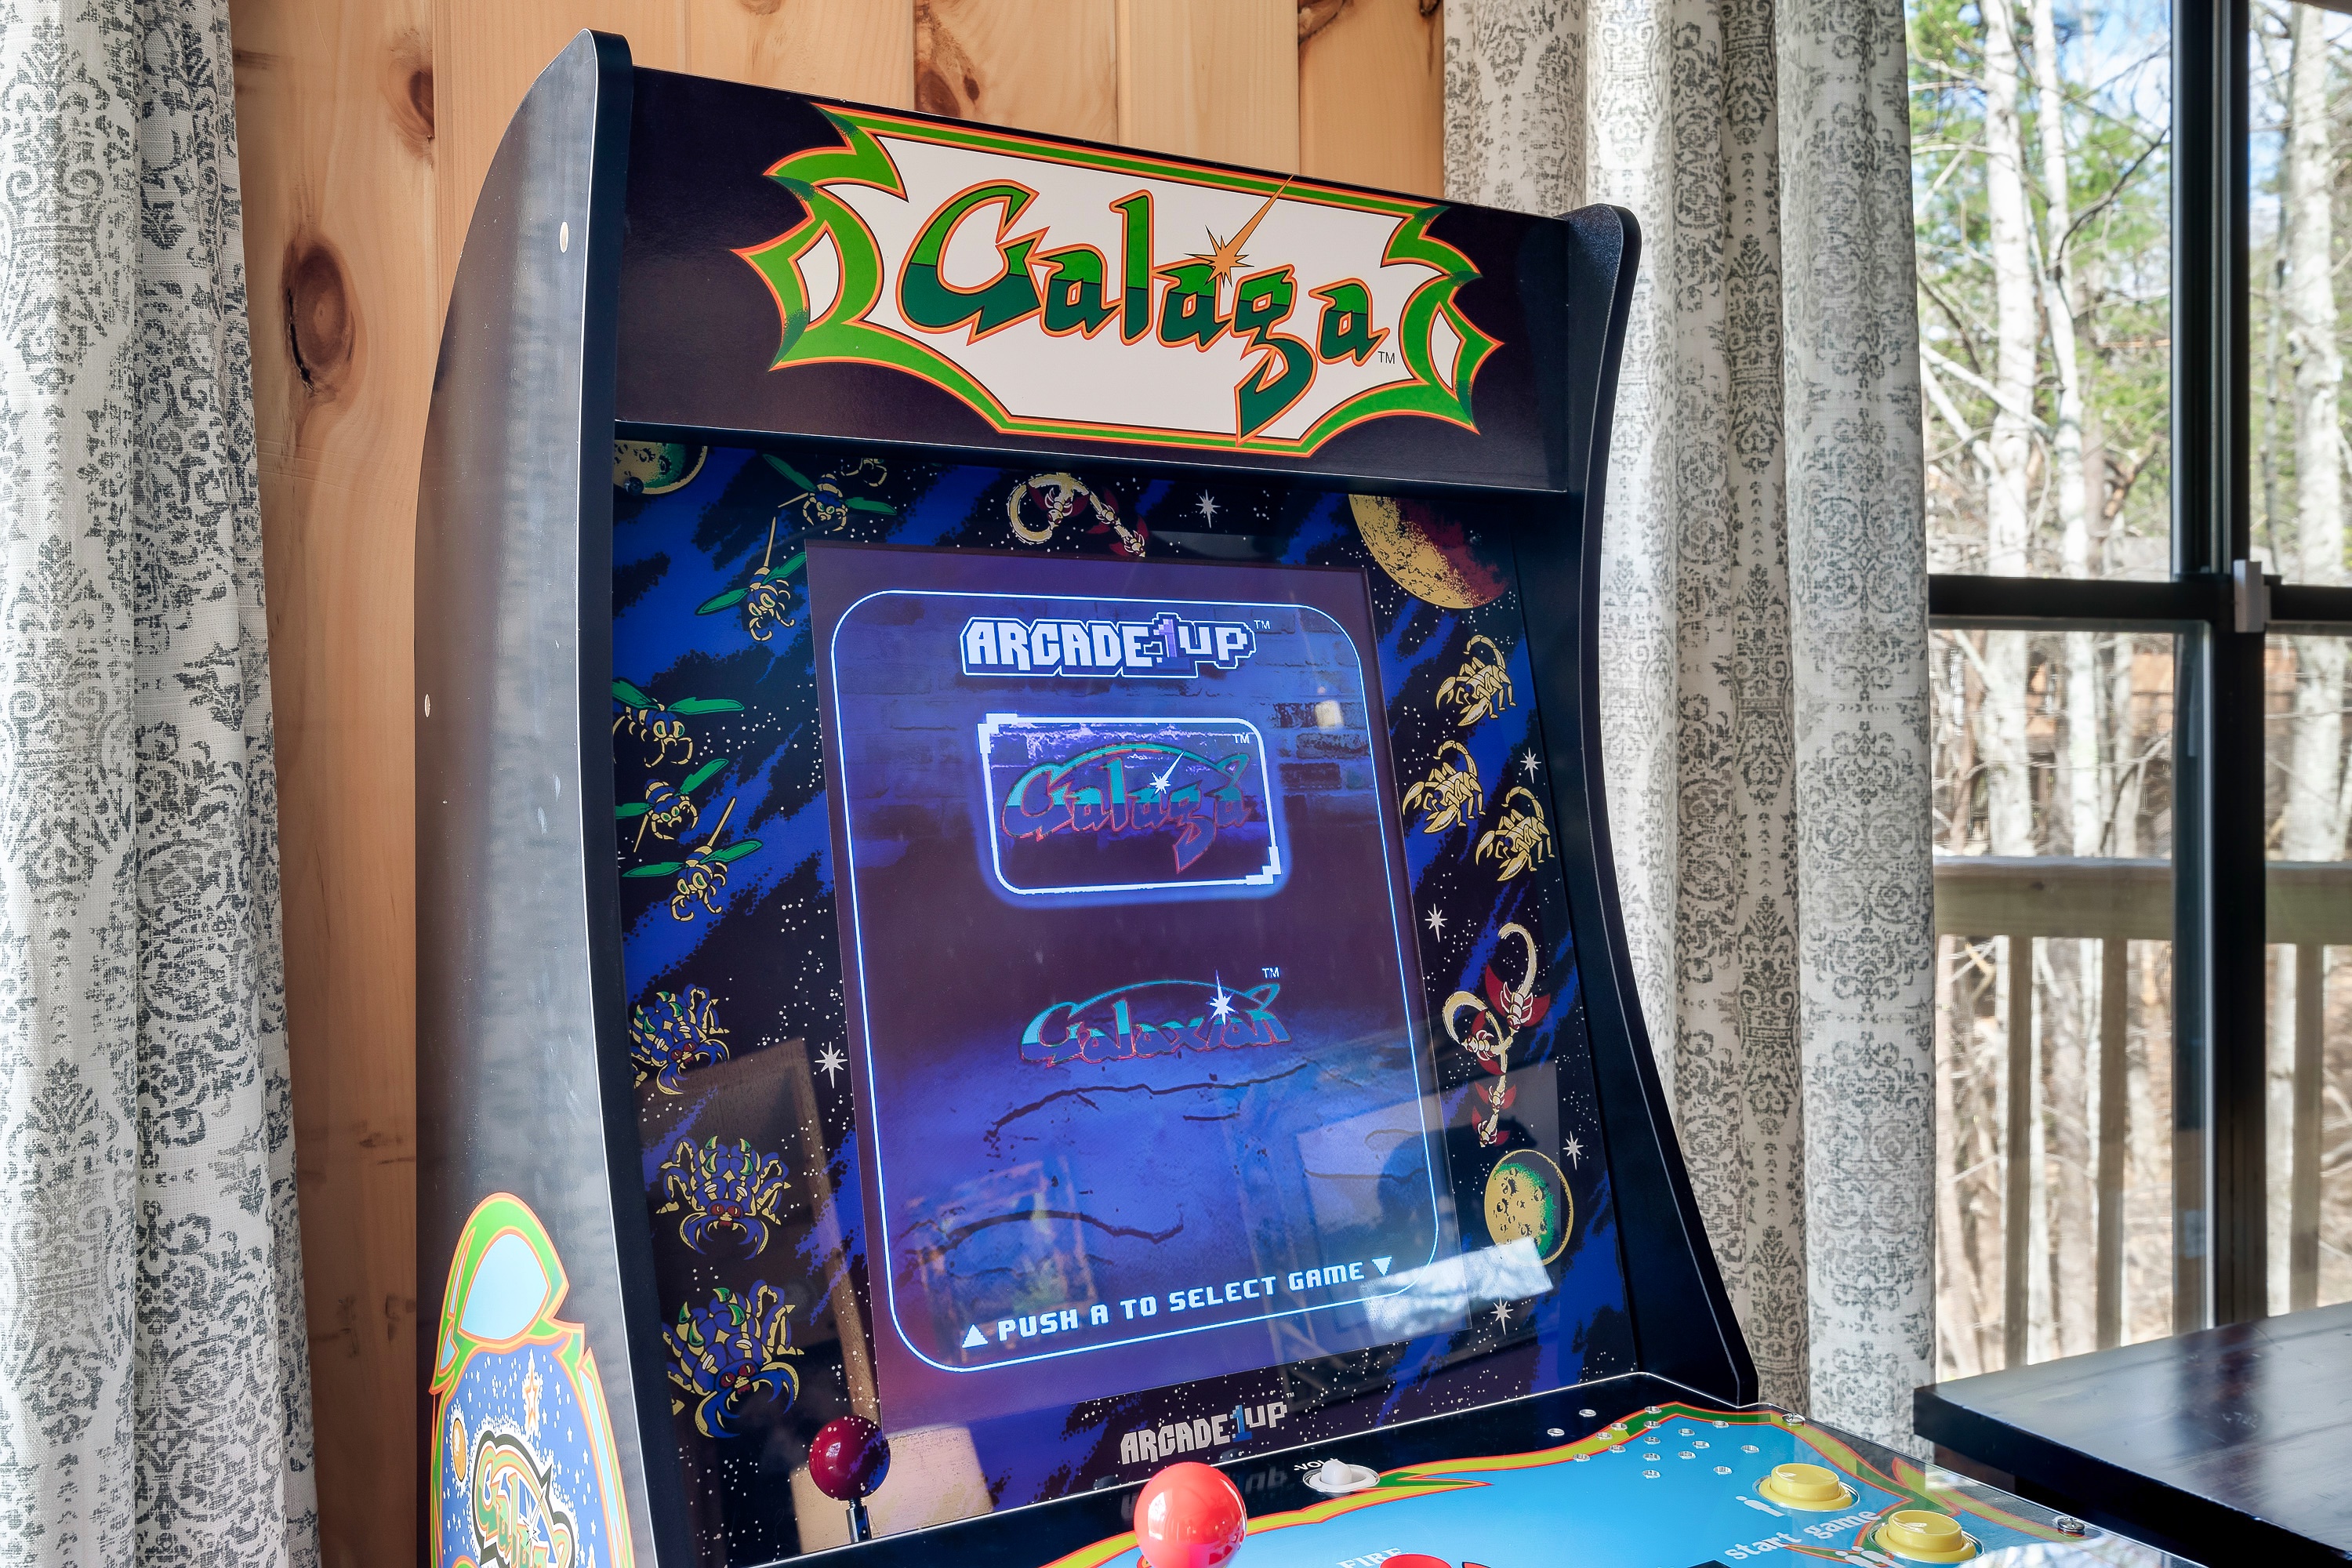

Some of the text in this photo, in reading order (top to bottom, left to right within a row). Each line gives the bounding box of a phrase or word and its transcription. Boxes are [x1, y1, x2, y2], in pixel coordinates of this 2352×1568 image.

[898, 179, 1396, 446] Galaga TM
[1254, 619, 1271, 630] TM
[1001, 734, 1252, 873] Galaga TM
[1020, 967, 1293, 1067] Galaxian TM
[997, 1261, 1366, 1341] PUSH A TO SELECT GAME
[1120, 1401, 1288, 1465] ARCADE1UP
[1724, 1510, 1882, 1560] start game
